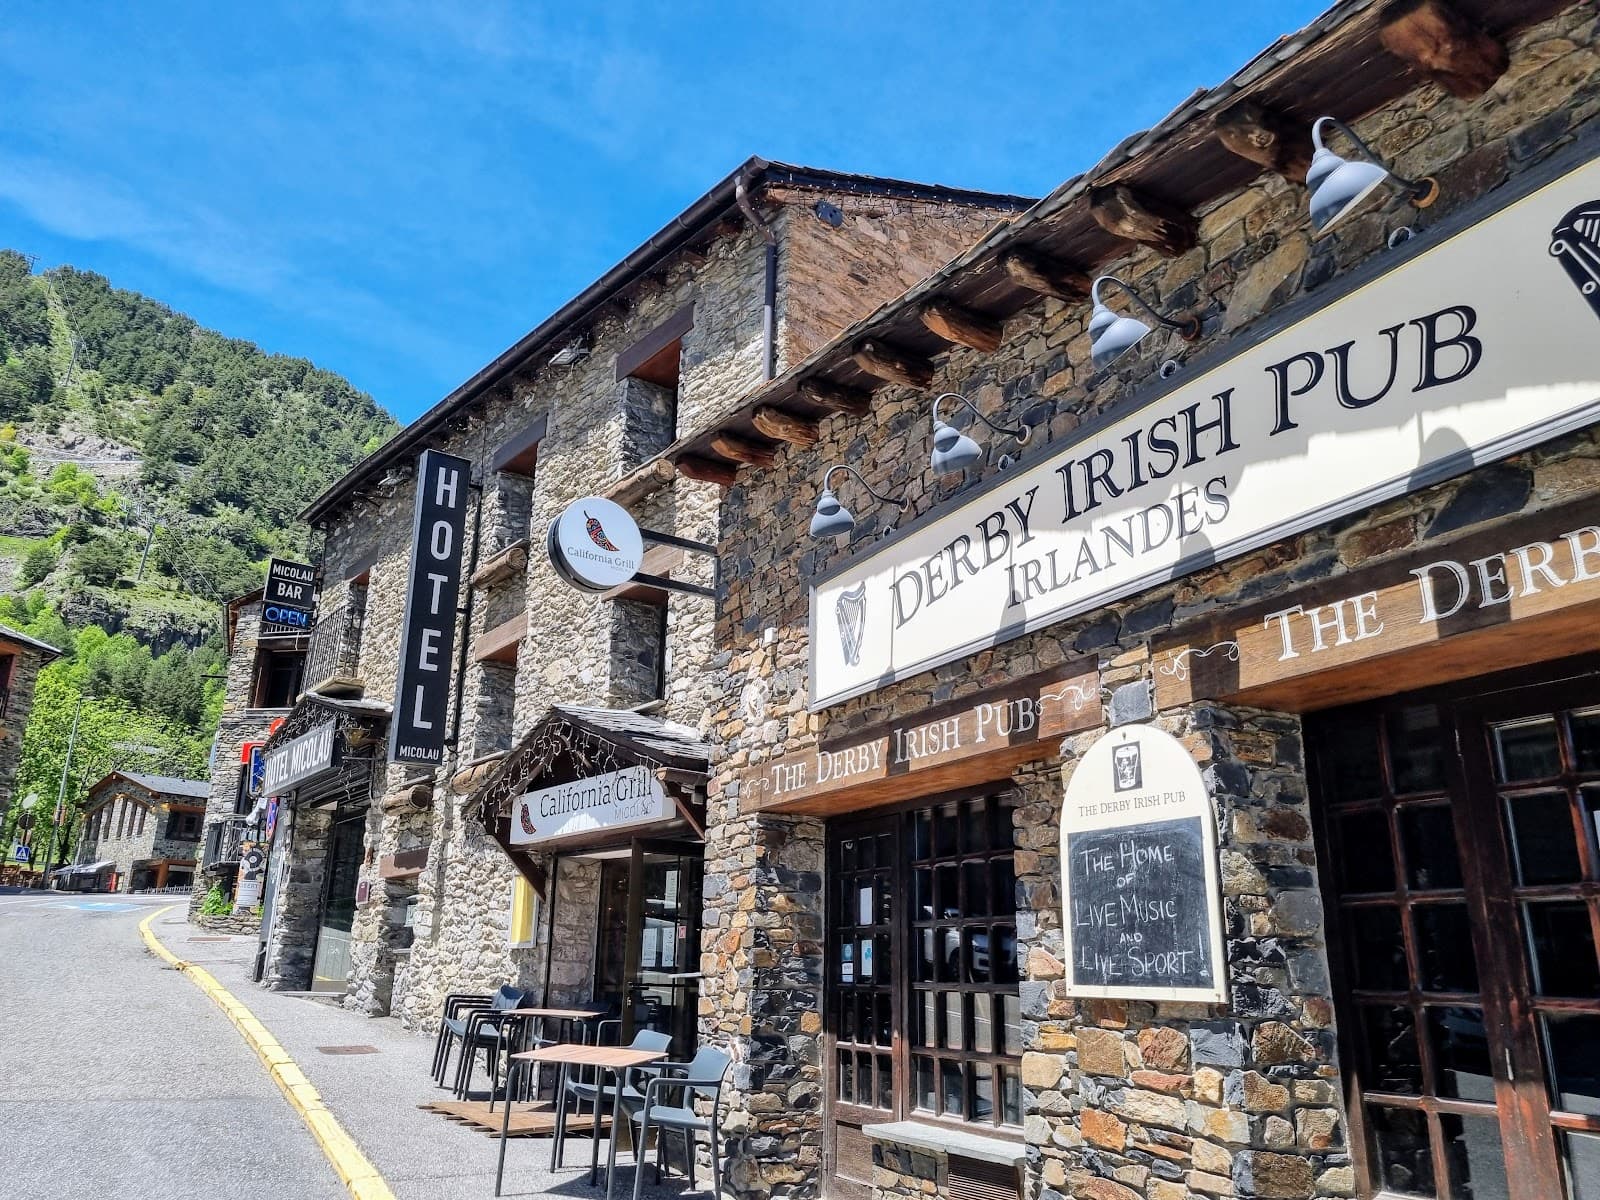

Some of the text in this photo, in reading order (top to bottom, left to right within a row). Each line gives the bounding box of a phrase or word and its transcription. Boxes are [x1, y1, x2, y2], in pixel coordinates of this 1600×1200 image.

[889, 305, 1482, 630] DERBY IRISH PUB
[567, 546, 634, 569] California Grill
[1004, 474, 1231, 609] IRLANDES
[272, 563, 314, 582] MICOLAU
[277, 582, 303, 600] BAR
[412, 466, 459, 730] HOTEL
[265, 606, 308, 627] OPEN
[1264, 591, 1384, 662] THE
[264, 749, 290, 790] HOTEL
[290, 727, 333, 778] MICOLAU
[399, 744, 440, 761] MICOLAU
[771, 696, 1037, 796] THE DERBY IRISH PUB
[540, 769, 653, 818] California Grill
[1078, 790, 1186, 818] THE DERBY IRISH PUB
[1079, 839, 1175, 876] THE HOME
[1116, 872, 1136, 889] OF
[1075, 894, 1179, 927] LIVE MUSIC
[1119, 931, 1143, 945] AND
[1081, 944, 1123, 977] LIVE
